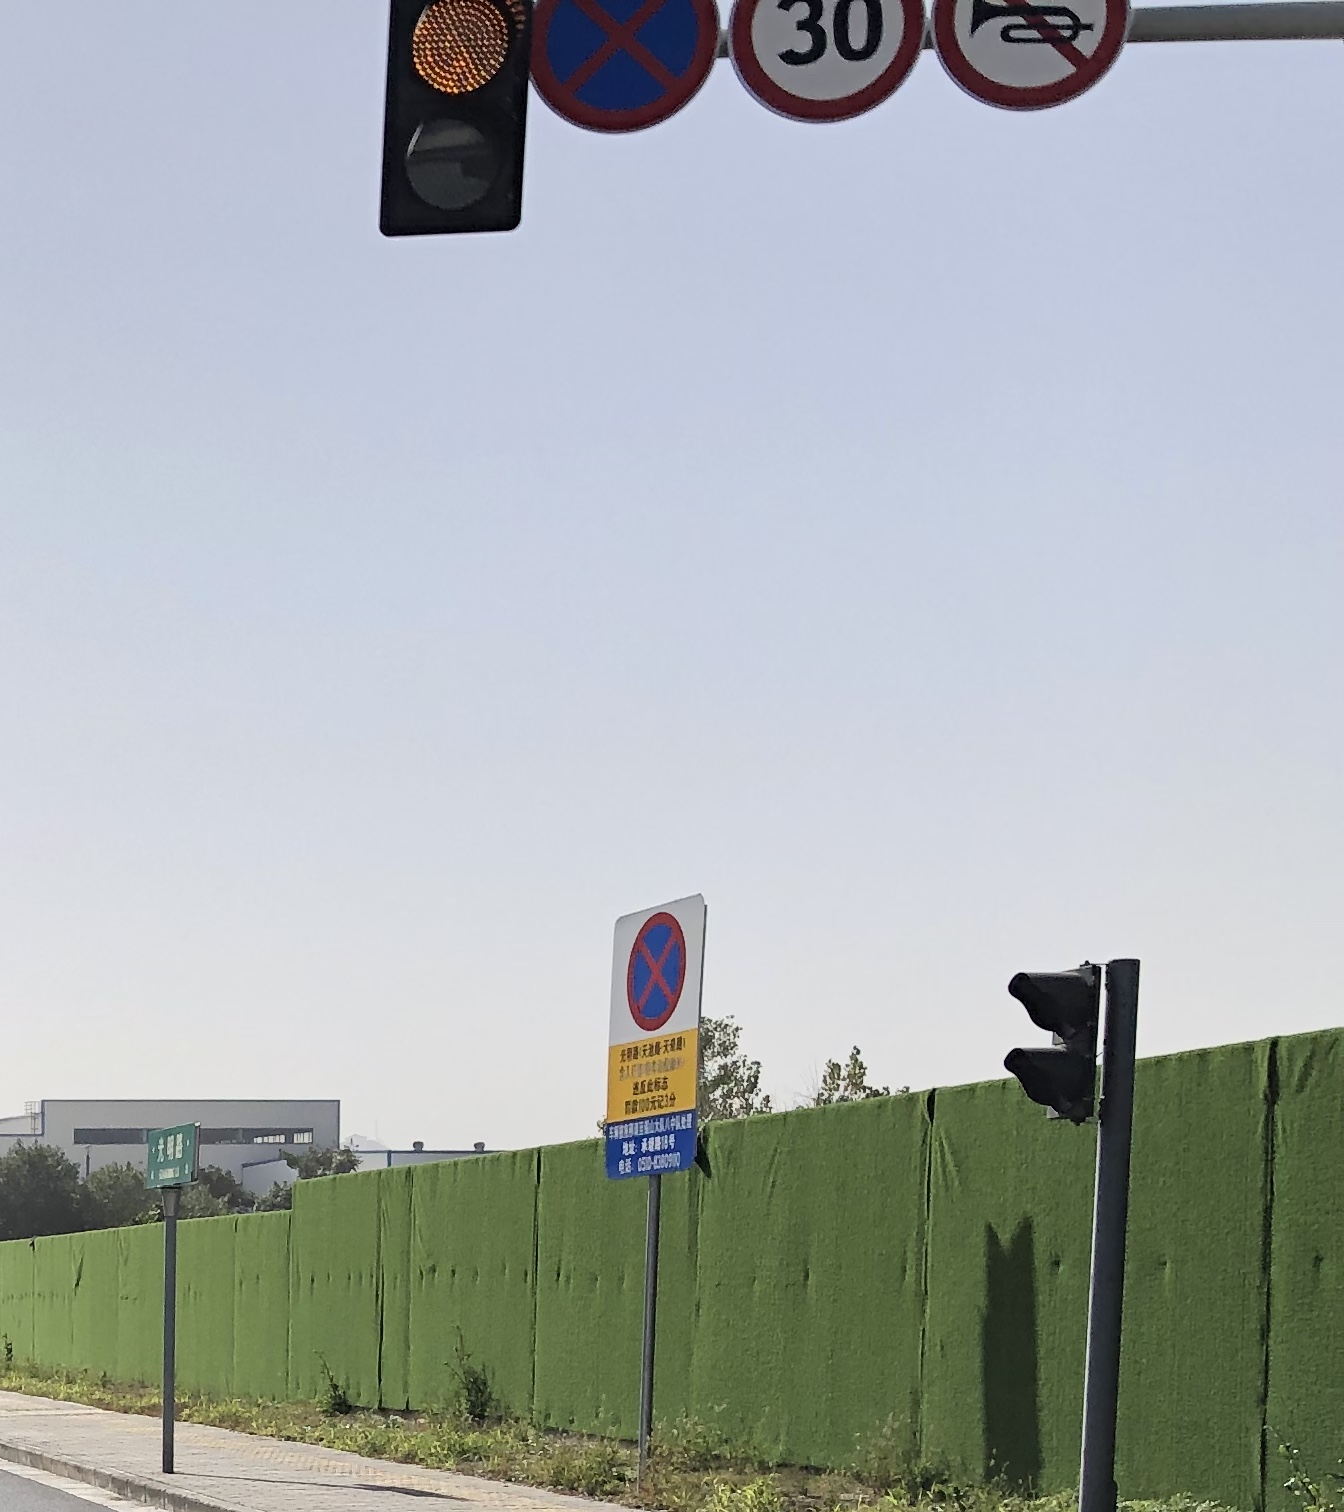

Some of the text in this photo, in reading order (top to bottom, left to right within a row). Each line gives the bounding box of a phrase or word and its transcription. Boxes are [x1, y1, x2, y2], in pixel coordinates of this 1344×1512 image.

[779, 0, 884, 66] 30
[632, 1076, 669, 1096] 违反此标志
[624, 1092, 677, 1116] 罚款100元记3分
